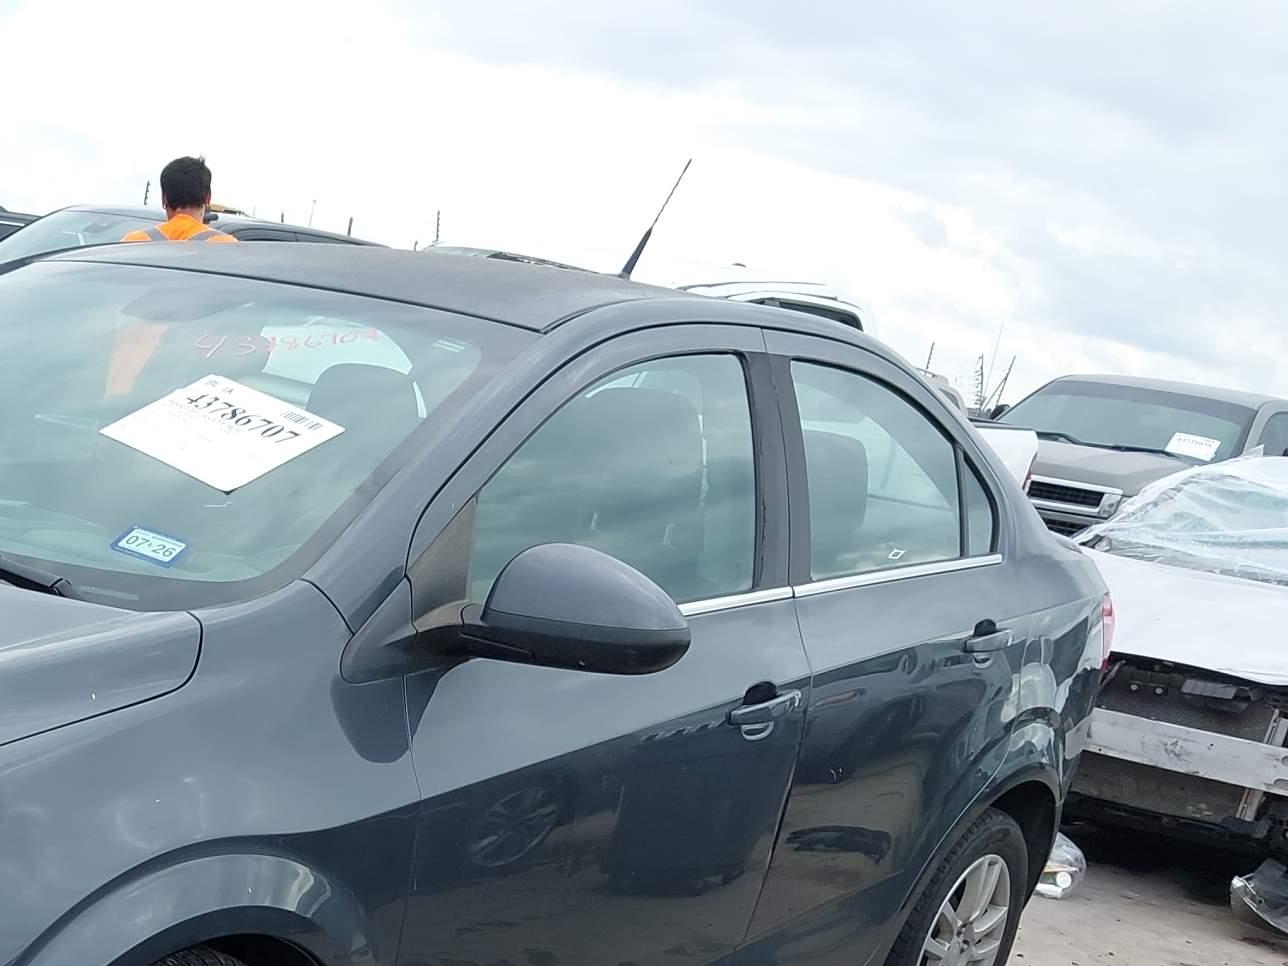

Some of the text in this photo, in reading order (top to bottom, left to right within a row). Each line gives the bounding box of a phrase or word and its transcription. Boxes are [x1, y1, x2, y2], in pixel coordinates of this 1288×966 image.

[186, 393, 302, 444] 43786707
[125, 535, 150, 547] 07
[152, 543, 176, 557] 26
